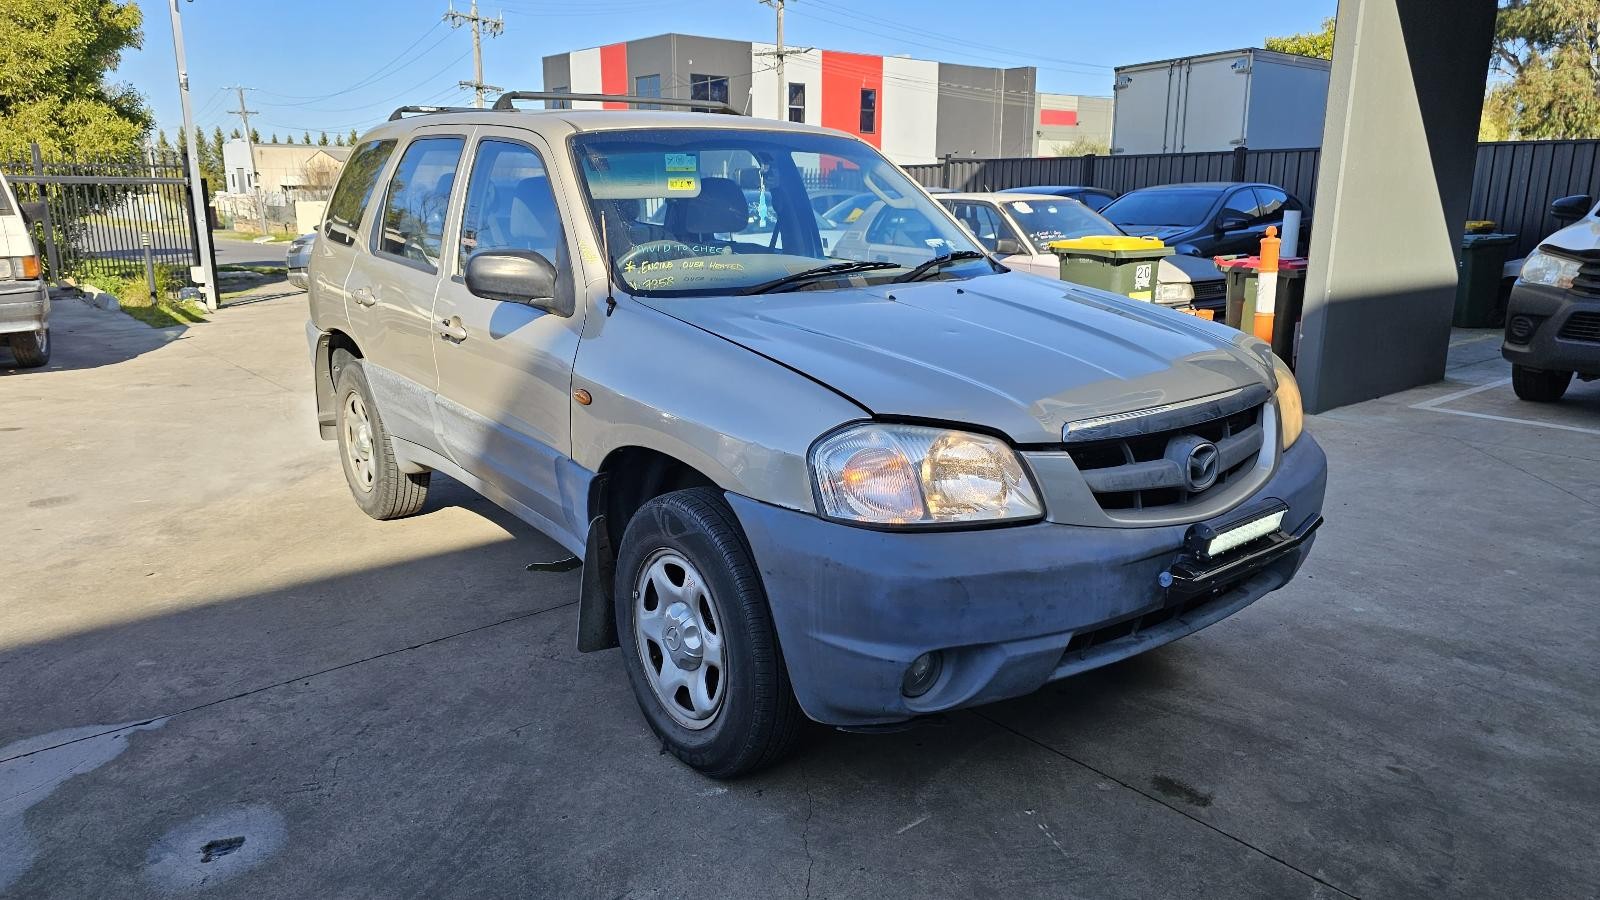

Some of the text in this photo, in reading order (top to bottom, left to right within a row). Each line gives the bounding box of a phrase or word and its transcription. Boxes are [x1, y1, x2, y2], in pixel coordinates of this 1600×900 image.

[692, 245, 726, 254] CHEC
[682, 261, 704, 270] OVER
[1137, 266, 1150, 279] 20
